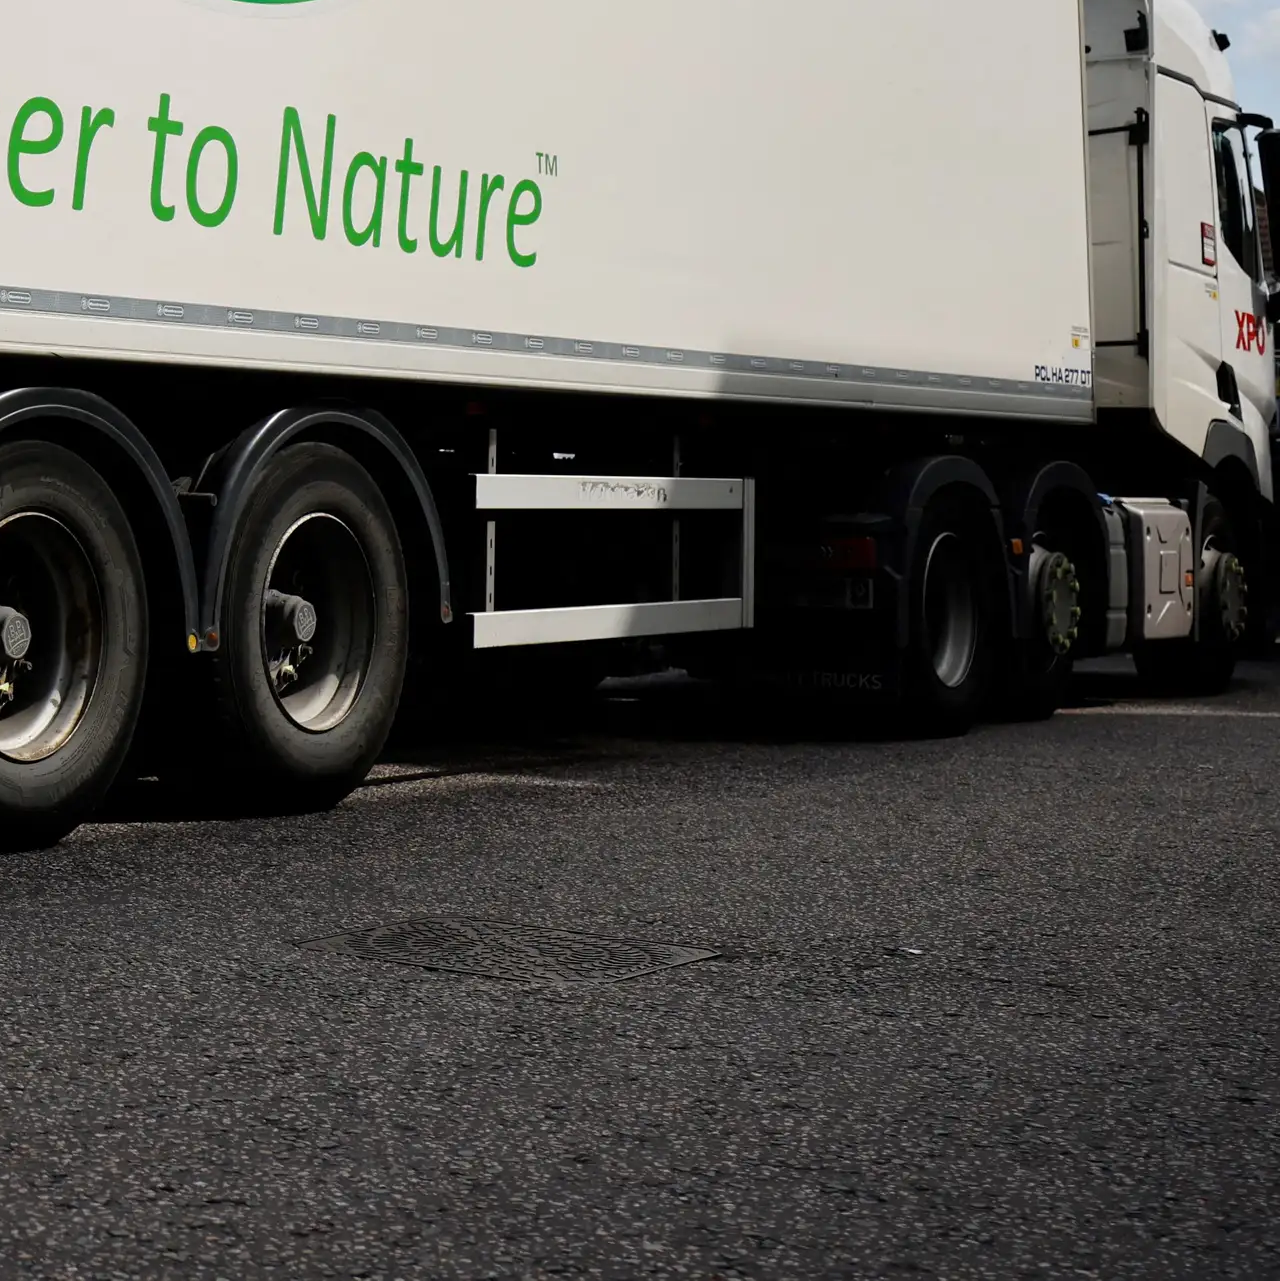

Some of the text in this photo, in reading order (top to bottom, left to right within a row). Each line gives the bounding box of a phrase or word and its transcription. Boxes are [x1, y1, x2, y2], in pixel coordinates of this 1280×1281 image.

[147, 93, 238, 228] to
[273, 106, 542, 268] Nature
[1234, 310, 1265, 356] XPO
[1035, 365, 1091, 386] PCL HA 277 DT
